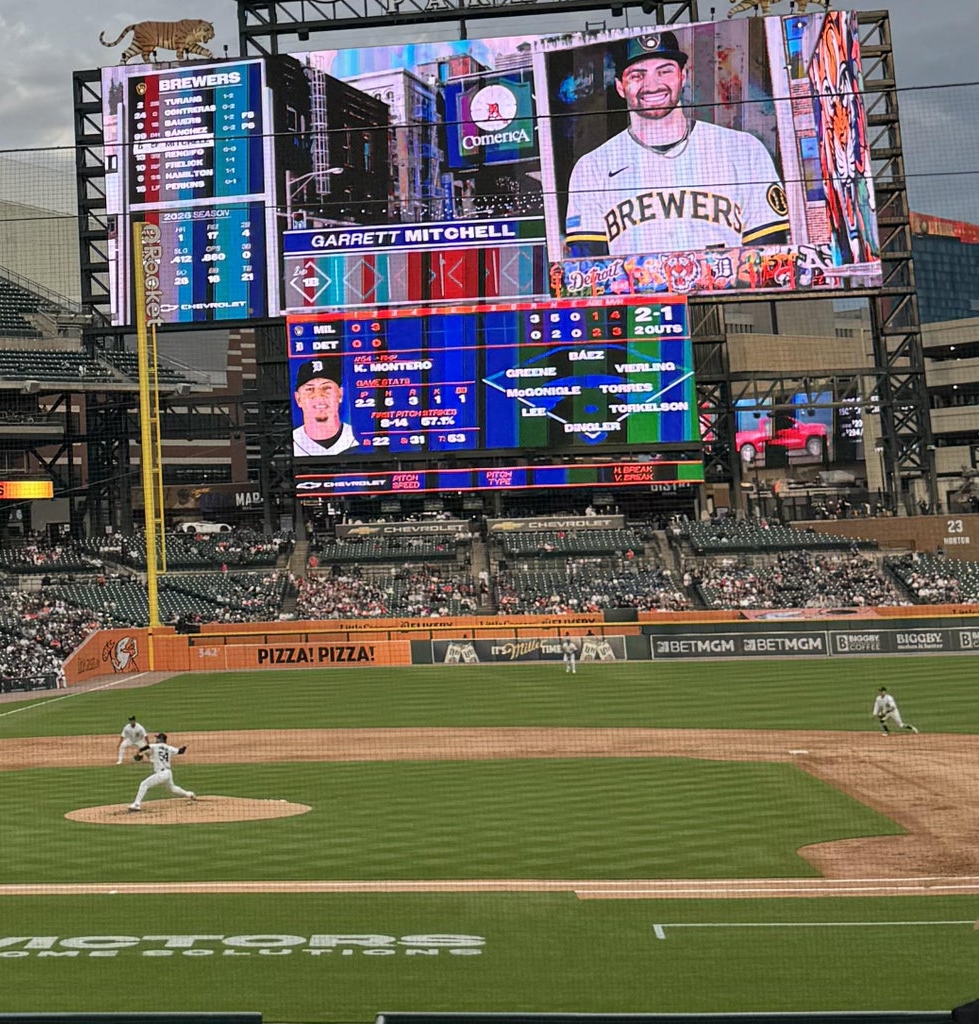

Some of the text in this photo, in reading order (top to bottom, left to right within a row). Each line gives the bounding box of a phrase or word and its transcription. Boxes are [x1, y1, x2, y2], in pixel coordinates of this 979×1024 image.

[159, 71, 242, 91] BREWERS
[164, 95, 203, 106] TURANG
[164, 104, 217, 116] CONTRERAS
[164, 116, 202, 127] BAUERS
[462, 128, 531, 150] Comerica
[164, 159, 204, 169] FRELICK
[165, 169, 214, 180] HAMILTON
[165, 181, 205, 191] PERKINS
[193, 210, 230, 219] SEASON
[604, 190, 745, 243] BREWERS
[207, 231, 219, 239] 17
[241, 229, 250, 237] 4
[311, 224, 516, 248] GARRETT MITCHELL
[242, 251, 251, 259] 0
[567, 259, 624, 292] Detroit
[142, 245, 165, 327] Rocket
[180, 301, 247, 310] CHEVROLET
[634, 306, 674, 323] 2-1
[313, 310, 621, 334] MIL 0 3 3 5 0 1 4
[312, 327, 622, 350] DET 0 0 0 2 0 2 3
[568, 349, 605, 361] BÁEZ
[353, 361, 433, 373] K. MONTERO
[505, 367, 557, 378] GREENE
[614, 362, 676, 373] VIERLING
[599, 383, 653, 394] TORRES
[384, 397, 395, 407] 5
[408, 396, 419, 406] 3
[434, 395, 442, 404] 1
[458, 394, 467, 403] 1
[522, 407, 547, 417] LEE
[608, 402, 689, 414] TORKELSON
[396, 410, 422, 418] PITCH
[564, 422, 621, 433] DINGLER
[372, 437, 390, 446] 22
[409, 435, 426, 445] 31
[486, 470, 513, 478] PITCH
[622, 465, 653, 474] BREAK
[391, 474, 419, 482] PITCH
[488, 477, 512, 485] TYPE
[622, 473, 654, 481] BREAK
[323, 479, 387, 489] CHEVROLET
[391, 481, 420, 489] SPEED
[383, 524, 464, 533] CHEVROLET
[528, 519, 612, 528] CHEVROLET
[947, 519, 963, 533] 23
[506, 640, 547, 660] Miller
[541, 644, 563, 654] TIME
[669, 637, 822, 653] BETMGM BETMGM
[850, 643, 880, 651] COFFEE
[257, 645, 375, 664] PIZZA! PIZZA!
[142, 948, 486, 958] SOLUTIONS
